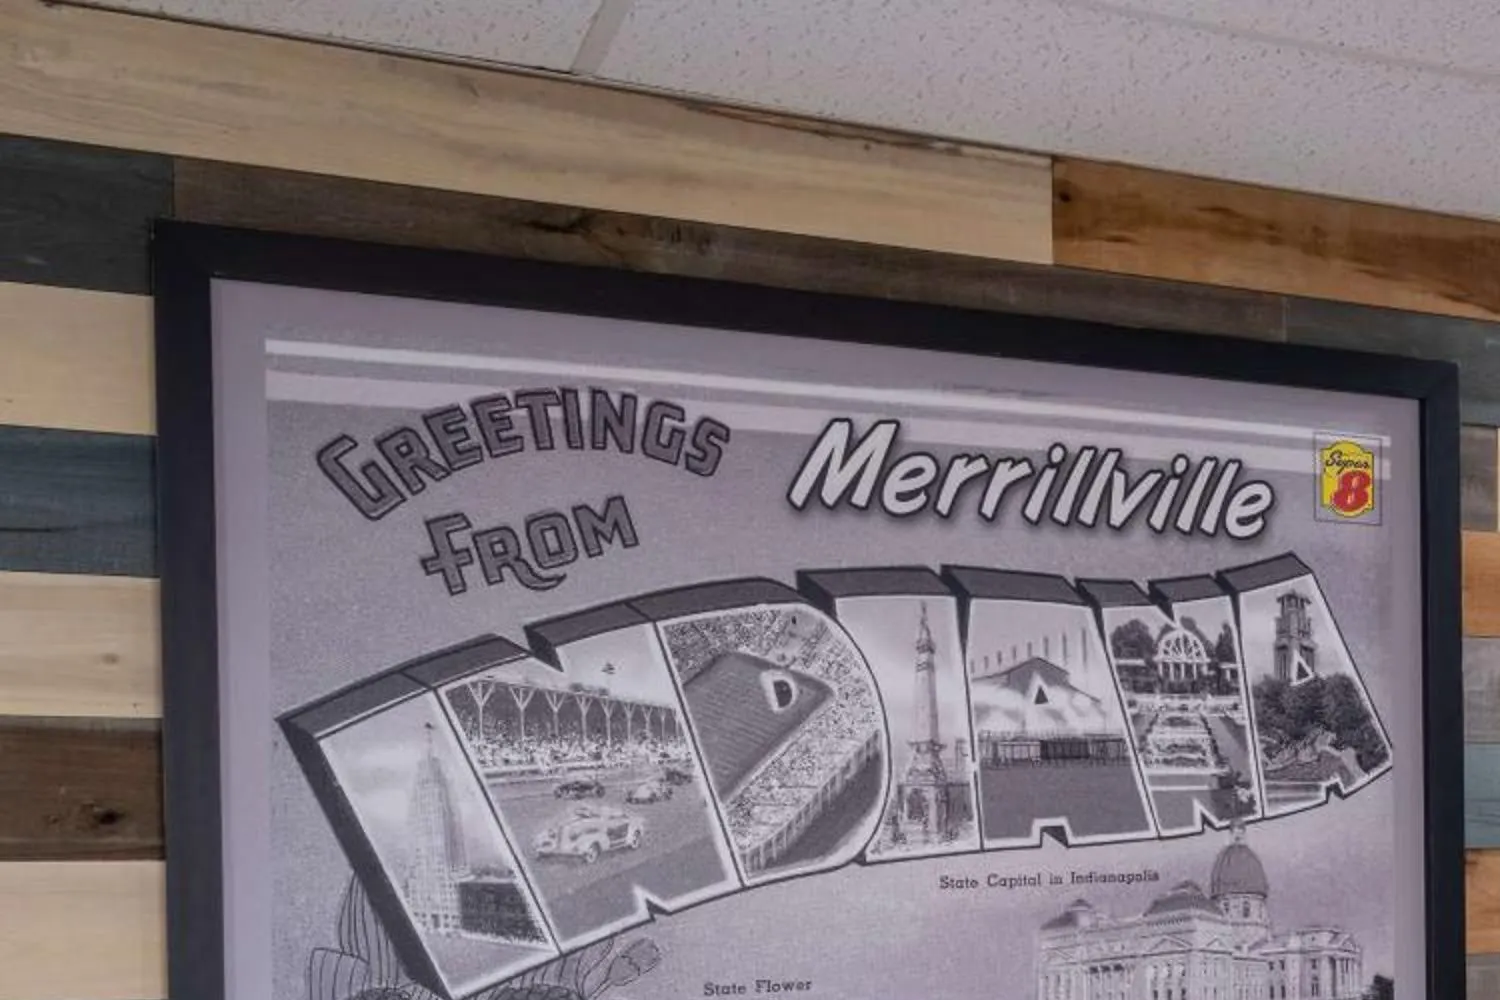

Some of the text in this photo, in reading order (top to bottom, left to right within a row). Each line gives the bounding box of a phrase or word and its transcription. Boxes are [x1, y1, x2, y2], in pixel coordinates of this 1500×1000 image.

[316, 386, 731, 520] GREETINGS
[787, 418, 1275, 540] Merrillville
[1332, 470, 1371, 513] 8
[420, 495, 640, 596] FROM
[939, 875, 979, 890] State
[1049, 874, 1063, 886] in
[1070, 869, 1160, 885] Indianapolis
[703, 979, 812, 996] State Flower
